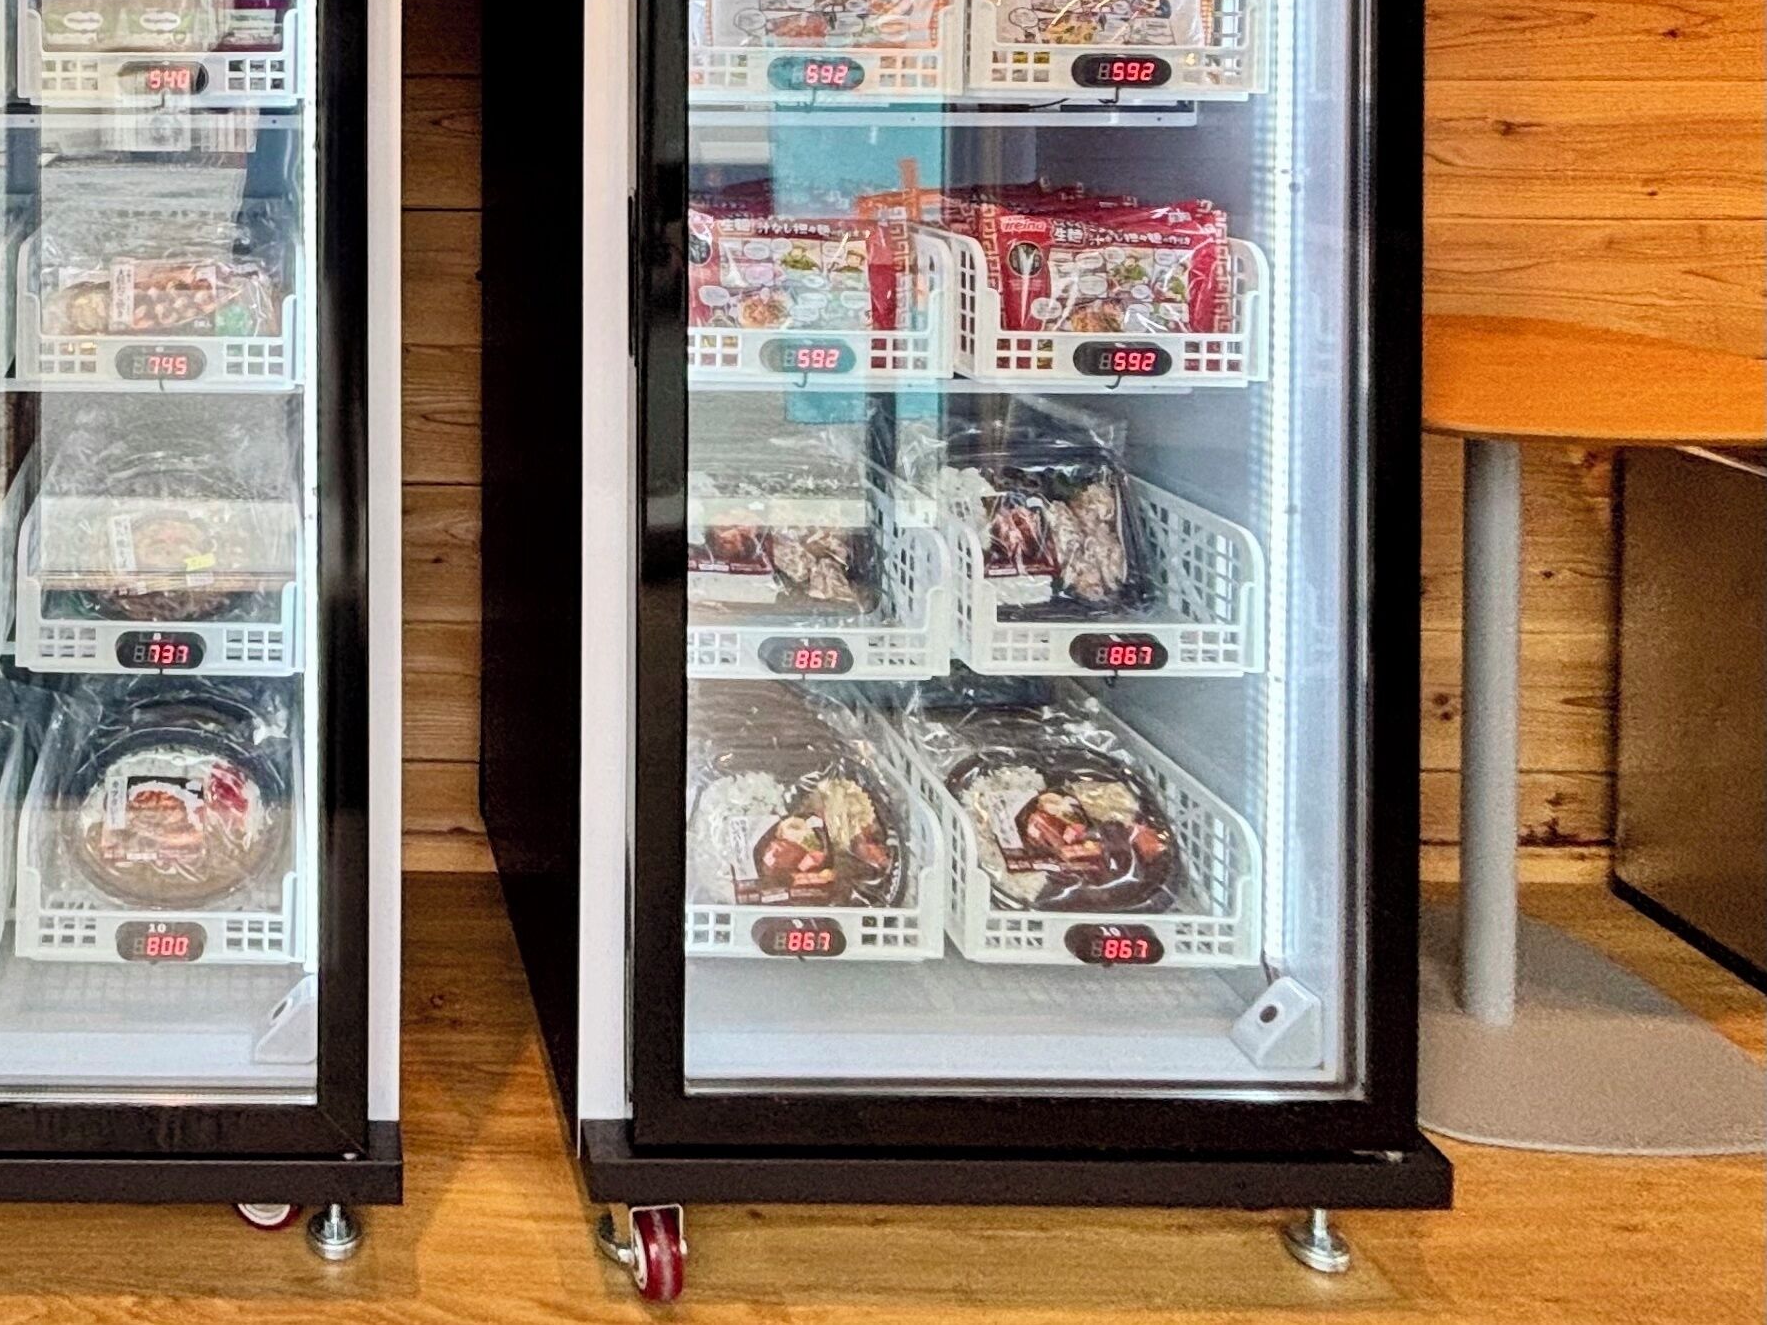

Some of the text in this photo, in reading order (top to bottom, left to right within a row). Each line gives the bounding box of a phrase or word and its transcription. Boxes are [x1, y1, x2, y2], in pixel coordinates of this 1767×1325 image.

[149, 70, 191, 88] 540
[806, 66, 849, 84] 592
[1112, 62, 1155, 81] 592
[149, 356, 187, 375] 745
[797, 350, 839, 368] 592
[1114, 352, 1156, 371] 592
[151, 645, 189, 663] 737
[795, 650, 838, 668] 867
[1109, 647, 1152, 665] 867
[146, 936, 189, 956] 800
[787, 932, 830, 951] 867
[1104, 939, 1148, 959] 867
